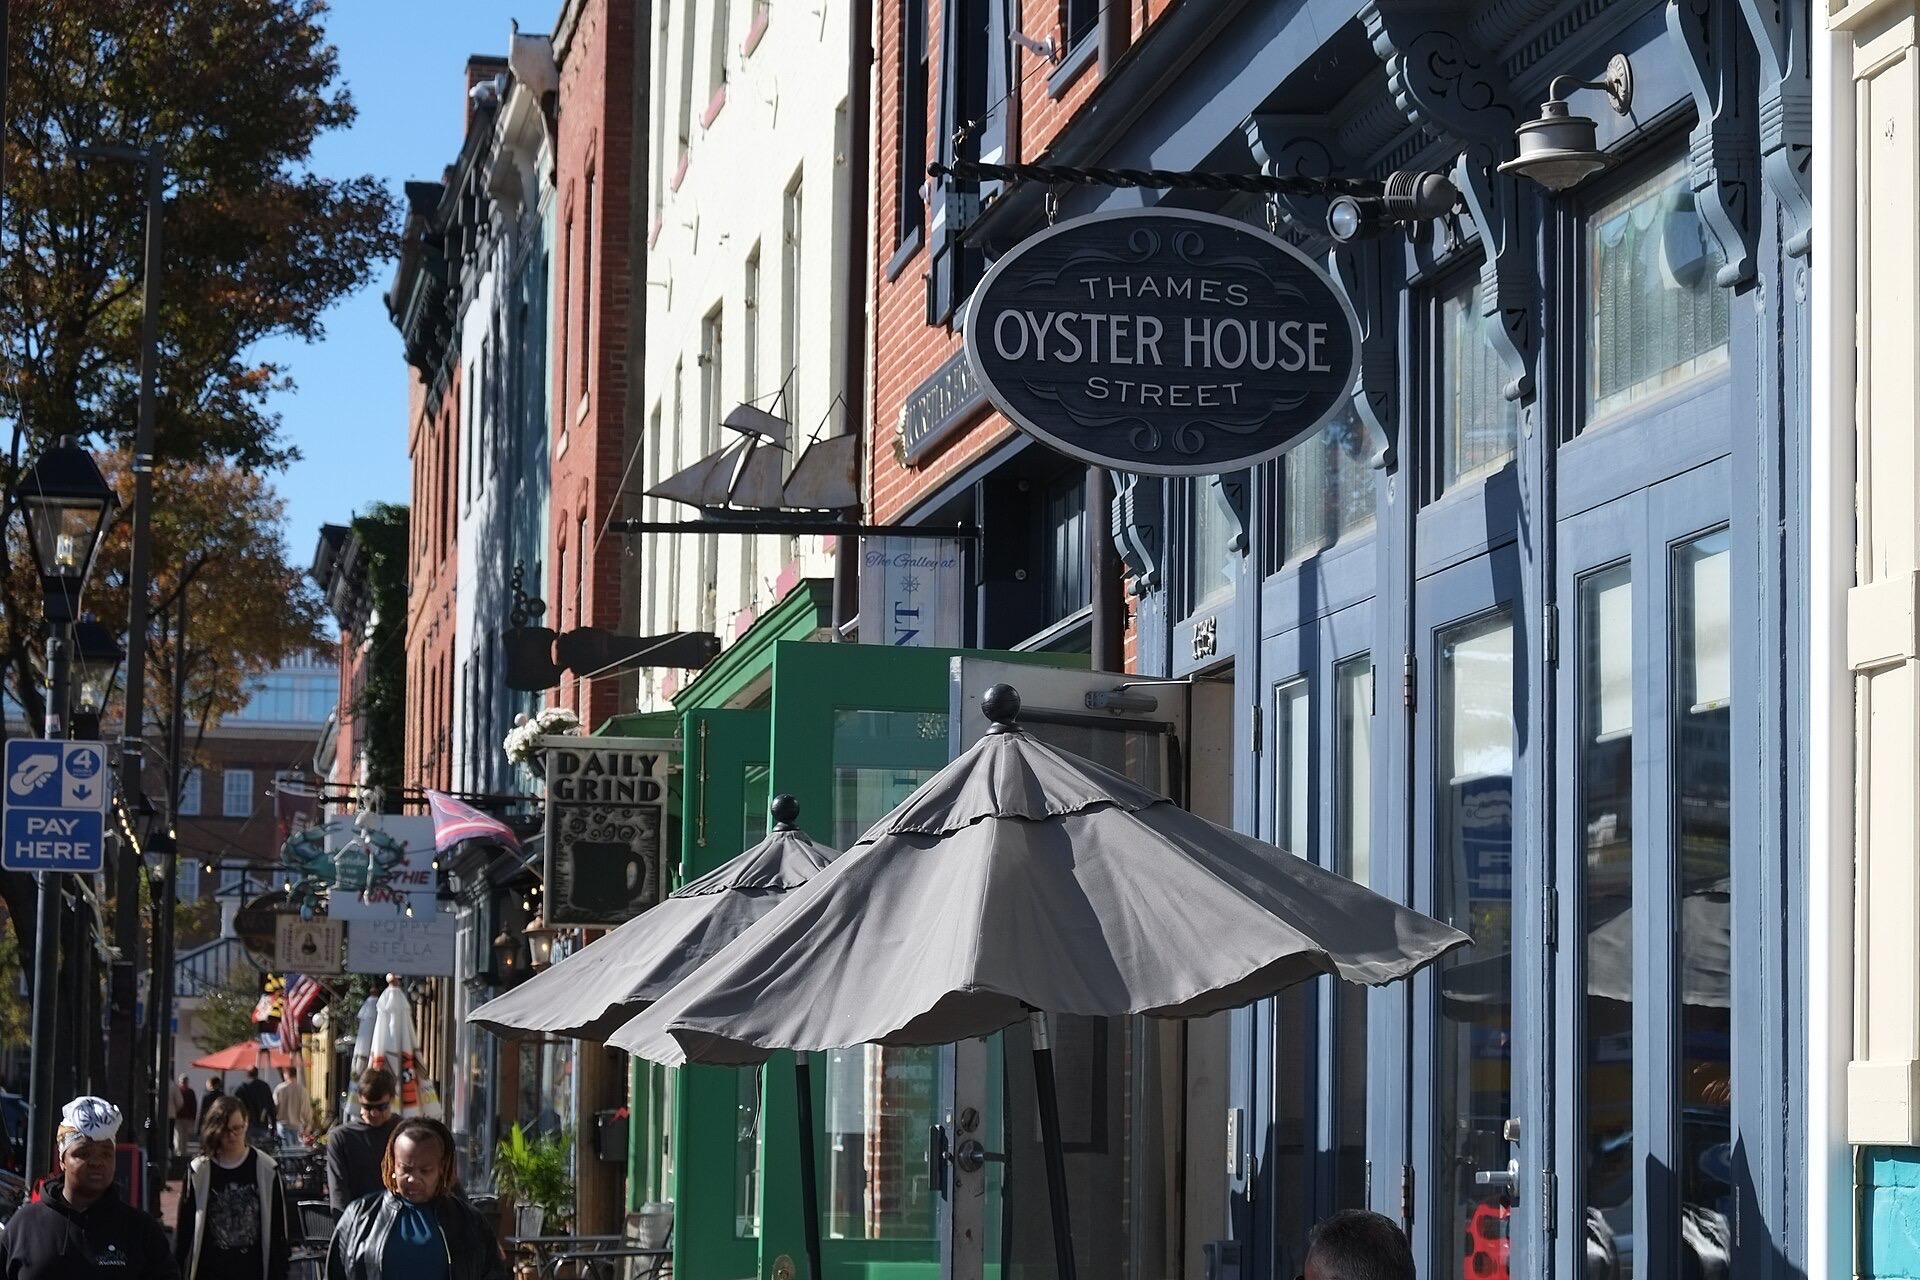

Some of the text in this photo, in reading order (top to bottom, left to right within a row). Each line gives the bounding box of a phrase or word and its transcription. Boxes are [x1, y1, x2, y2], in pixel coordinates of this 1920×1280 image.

[1079, 275, 1249, 306] THAMES
[993, 309, 1331, 373] OYSTER HOUSE
[1085, 376, 1243, 407] STREET
[865, 551, 956, 571] The Galley at
[73, 750, 92, 770] 4
[558, 752, 660, 777] DAILY
[552, 777, 661, 801] GRIND
[27, 817, 80, 836] PAY
[15, 841, 91, 860] HERE
[369, 941, 432, 955] STELLA
